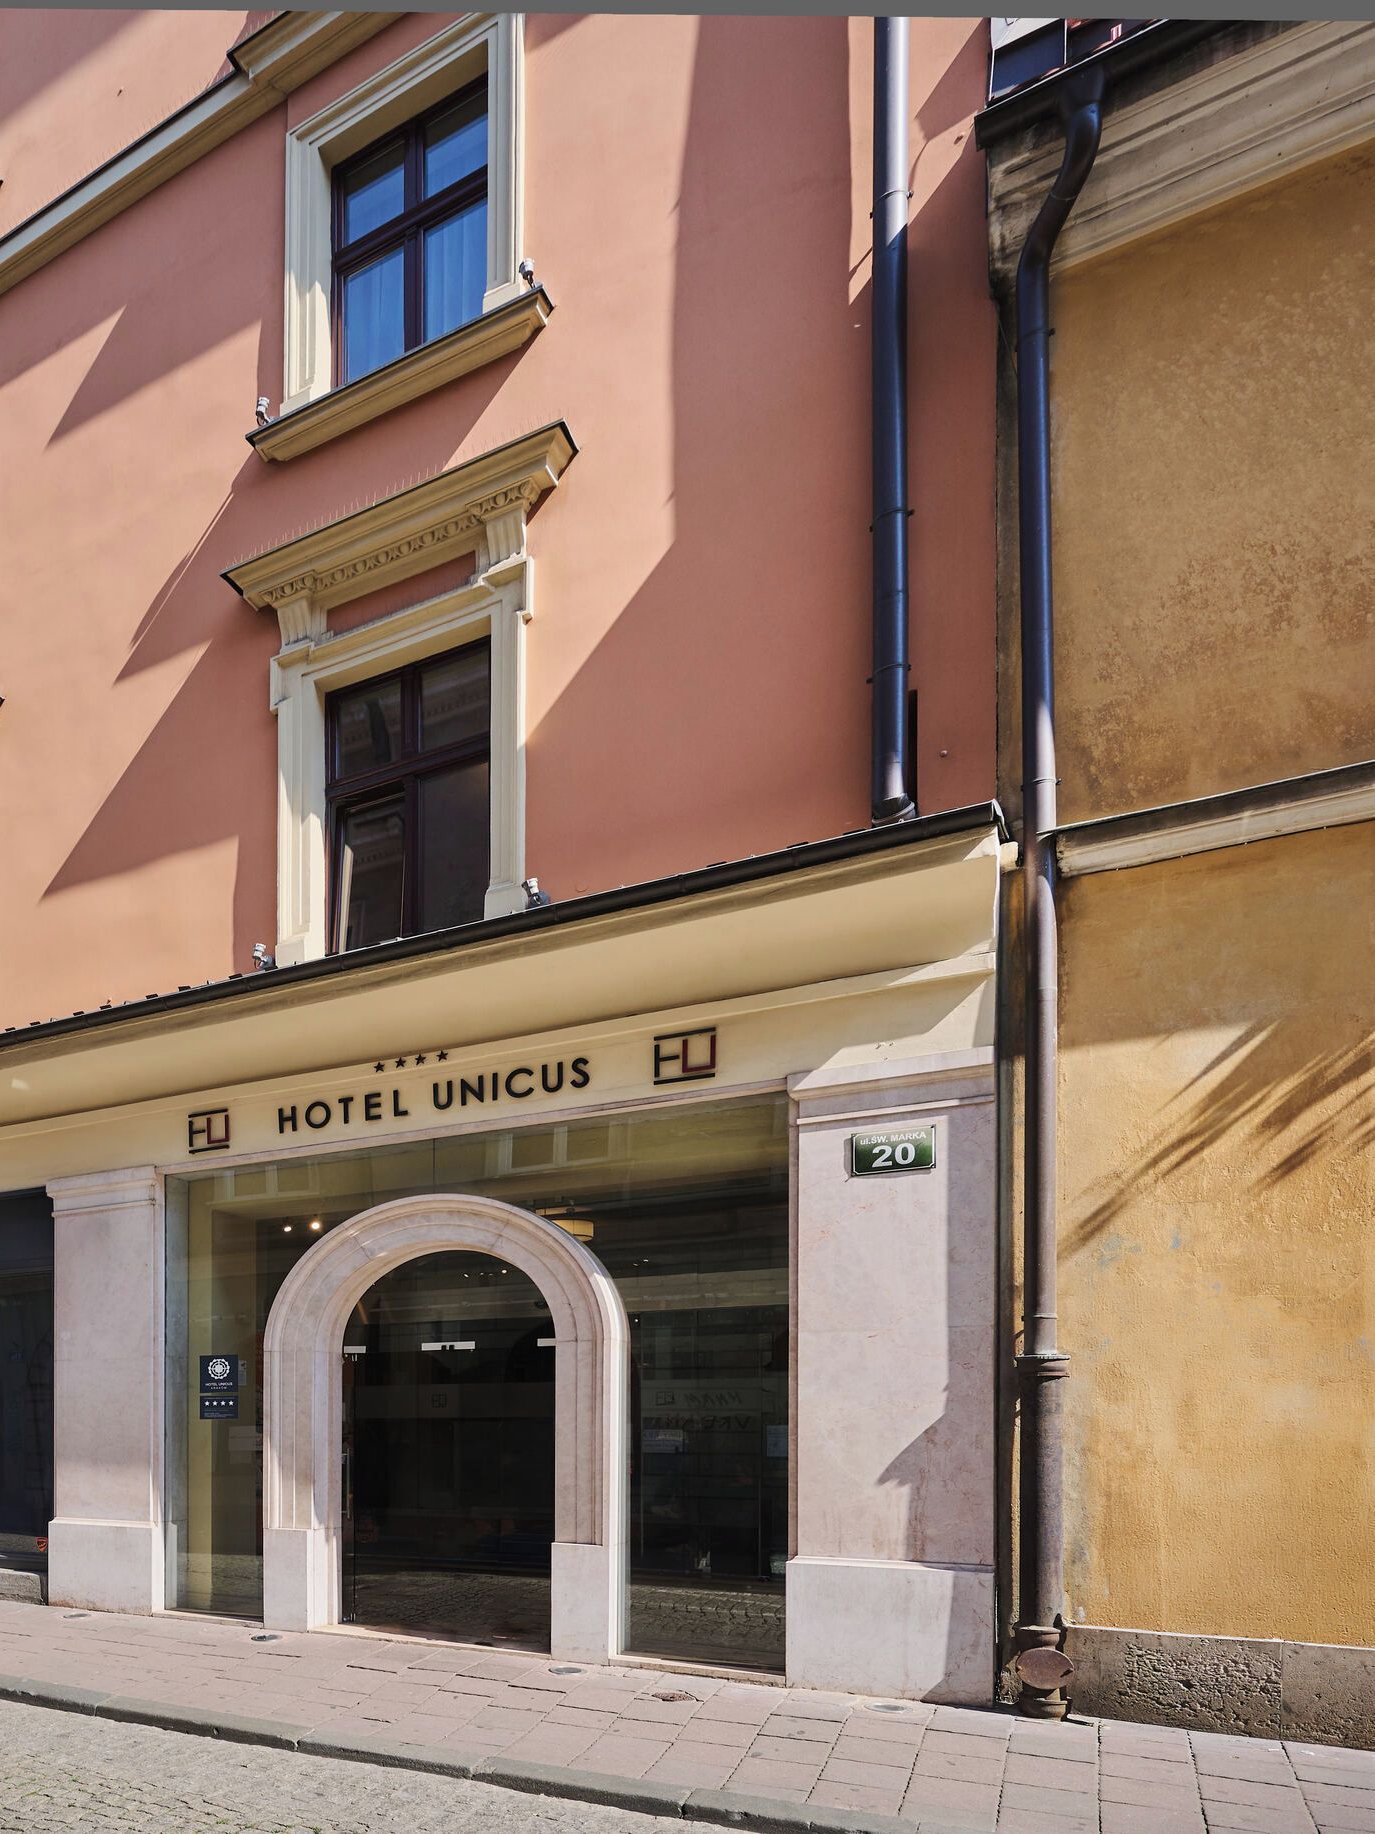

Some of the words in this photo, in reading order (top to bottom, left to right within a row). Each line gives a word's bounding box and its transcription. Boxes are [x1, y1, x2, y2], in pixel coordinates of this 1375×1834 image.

[277, 1088, 409, 1134] HOTEL
[432, 1056, 591, 1111] UNICUS
[890, 1131, 927, 1142] MARKA
[871, 1142, 916, 1168] 20
